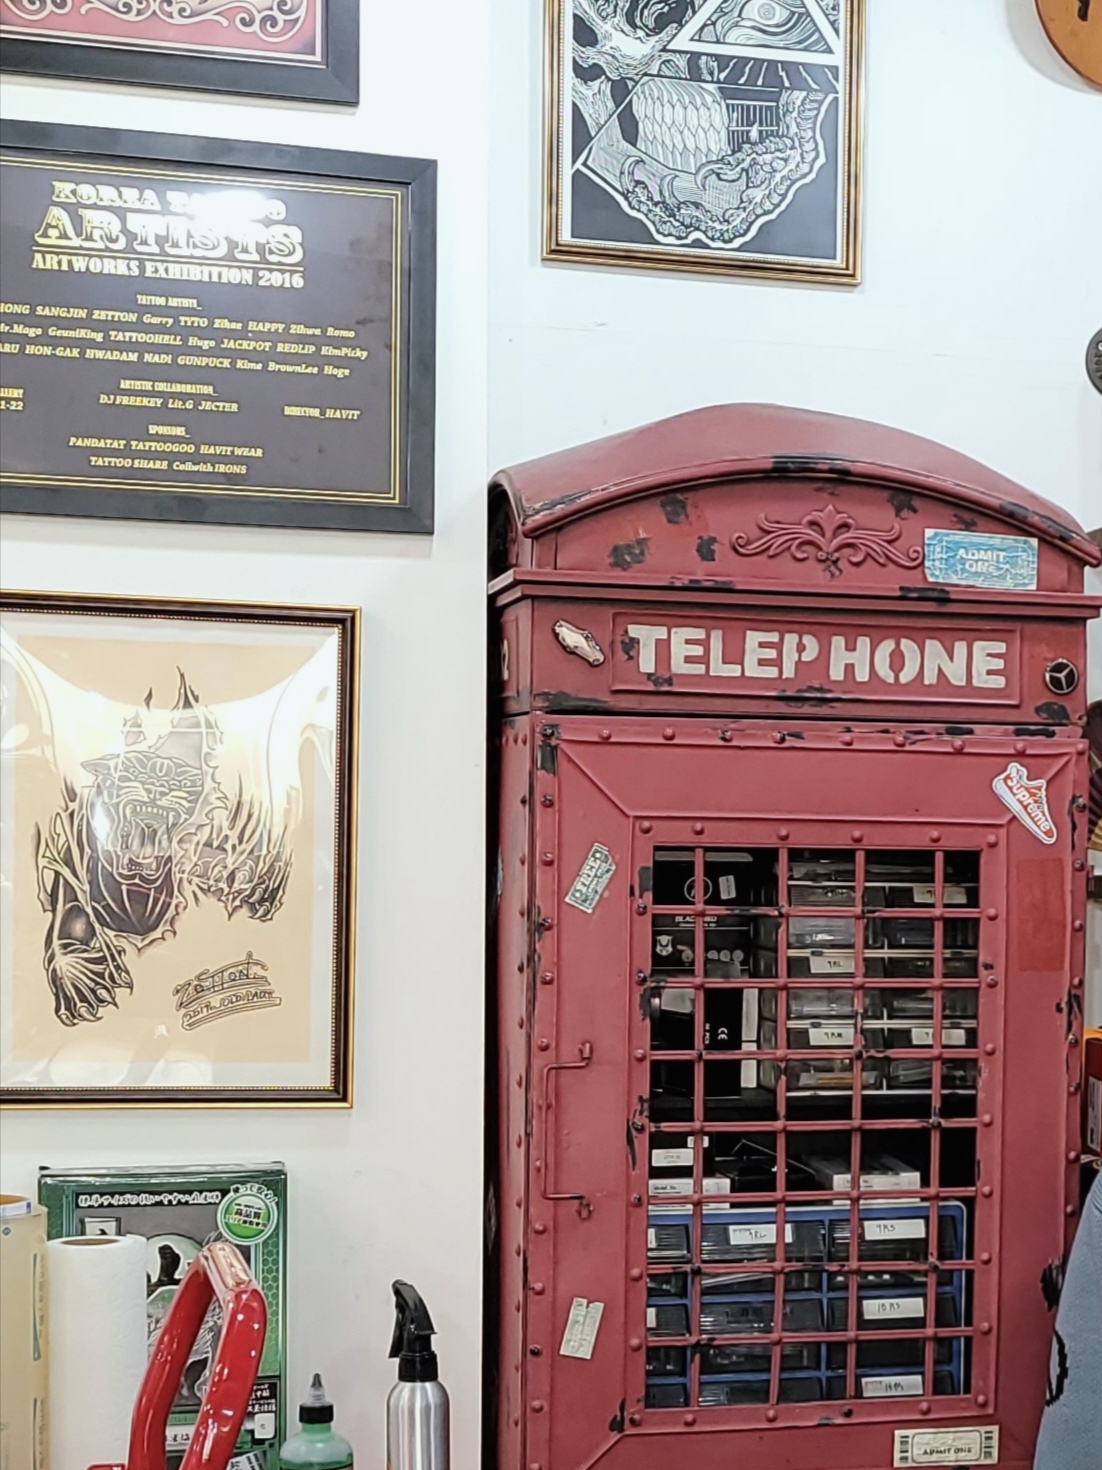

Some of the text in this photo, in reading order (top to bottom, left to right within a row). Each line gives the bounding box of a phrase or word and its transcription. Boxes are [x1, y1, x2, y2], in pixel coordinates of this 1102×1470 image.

[34, 206, 304, 264] ARTISTS
[32, 253, 304, 288] ARTWORKS EXHIBITION 2016
[36, 306, 88, 318] SANGJIN
[92, 309, 138, 322] ZETTON
[142, 313, 174, 327] Garry
[248, 321, 285, 333] HAPPY
[109, 330, 183, 345] TATTOOHELL
[188, 337, 216, 349] Hugo
[220, 338, 272, 352] JACKPOT
[276, 342, 317, 355] REDLIP
[25, 344, 80, 357] HON-GAK
[85, 348, 139, 362] HWADAM
[177, 354, 231, 368] GUNPUCK
[130, 440, 195, 453] TATTOOGOO
[957, 547, 1006, 563] ADMIT
[965, 560, 999, 573] ONE
[627, 624, 1007, 688] TELEPHONE
[1005, 777, 1051, 832] Supreme
[922, 1446, 974, 1456] ADMIT ONE
